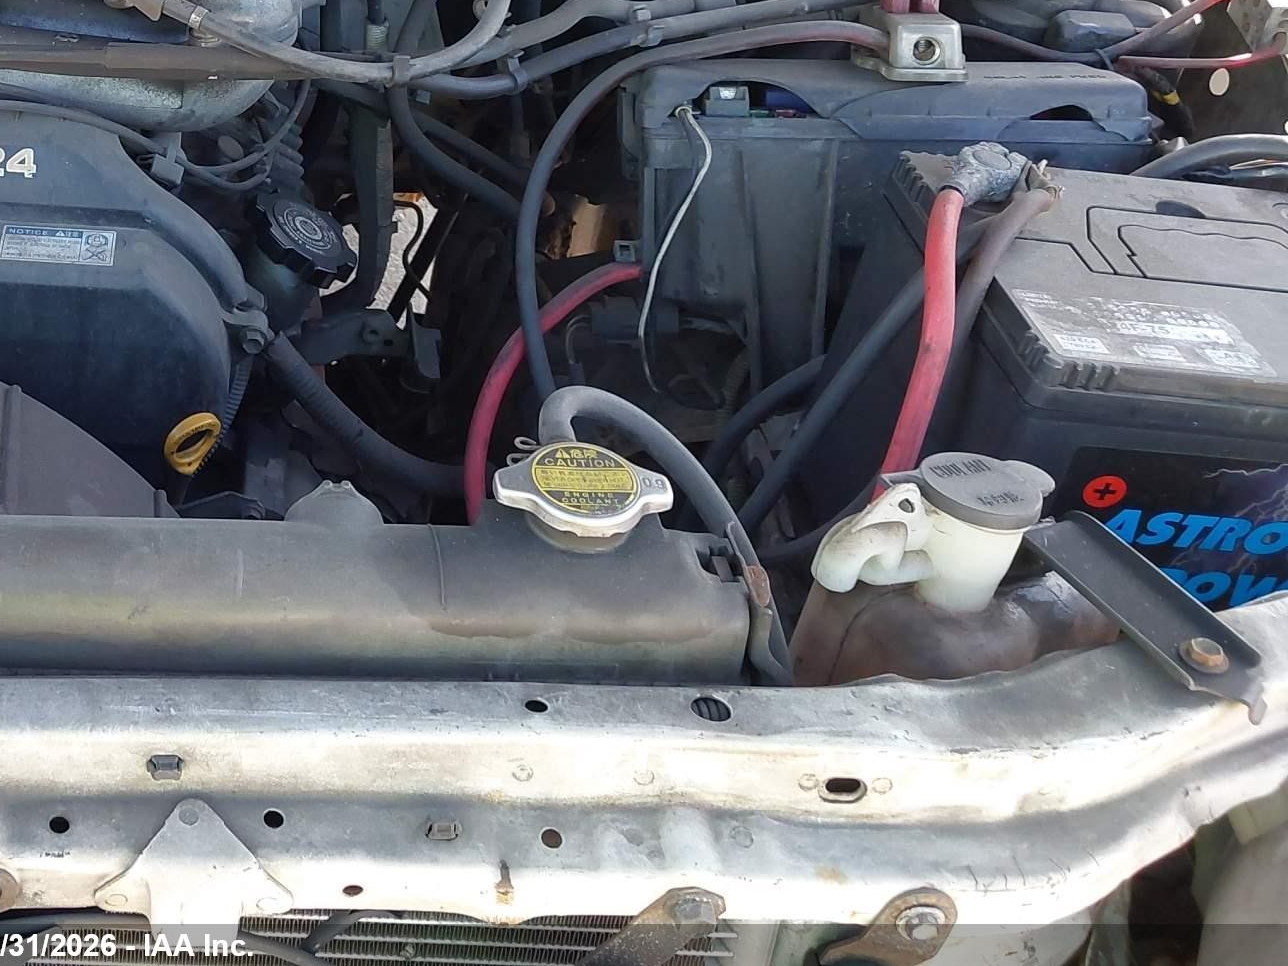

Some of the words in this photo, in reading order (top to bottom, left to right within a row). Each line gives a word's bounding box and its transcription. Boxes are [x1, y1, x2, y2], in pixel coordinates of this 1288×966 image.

[9, 227, 48, 236] NOTICE
[544, 457, 616, 468] CAUTION
[564, 491, 614, 499] ENGINE
[562, 497, 619, 505] COOLANT
[1106, 508, 1288, 555] ASTRO
